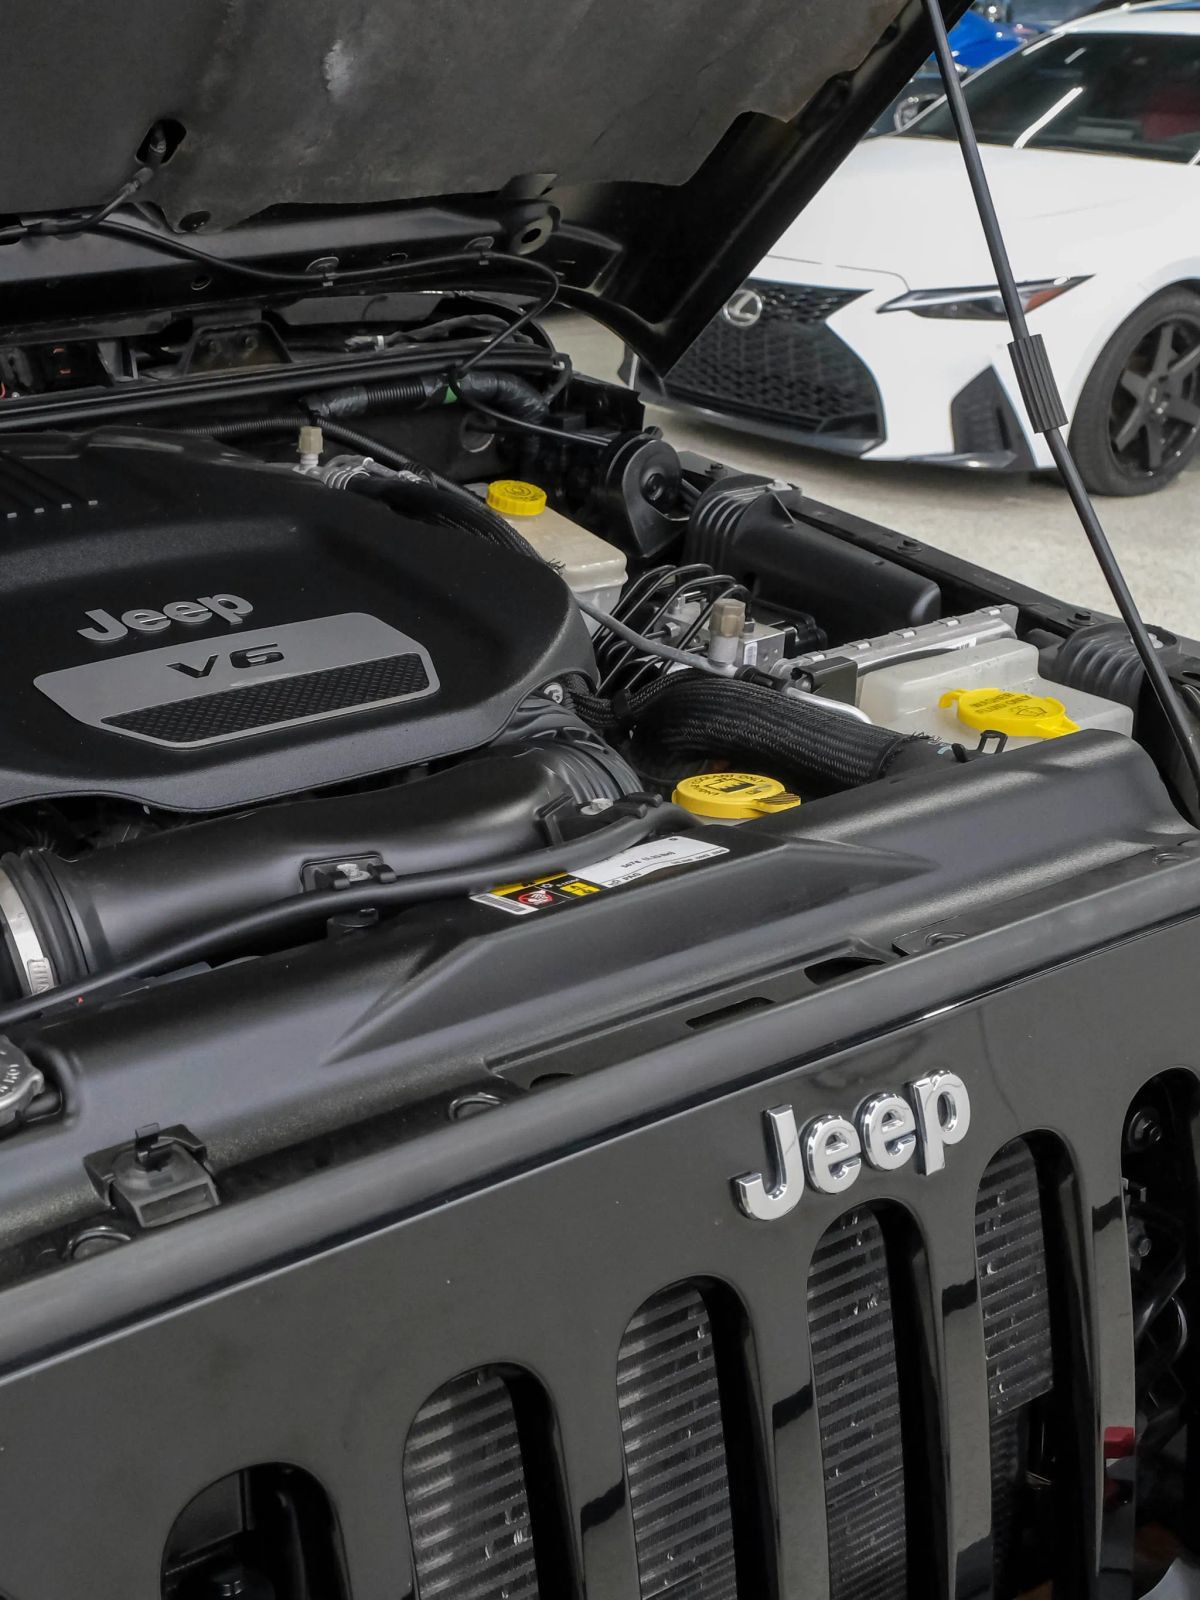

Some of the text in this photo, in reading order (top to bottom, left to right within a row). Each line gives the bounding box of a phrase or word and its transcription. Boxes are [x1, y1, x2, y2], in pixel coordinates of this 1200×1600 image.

[76, 592, 255, 643] Jeep
[166, 643, 286, 679] V6
[970, 693, 1014, 707] WASHER
[729, 1069, 971, 1220] Jeep
